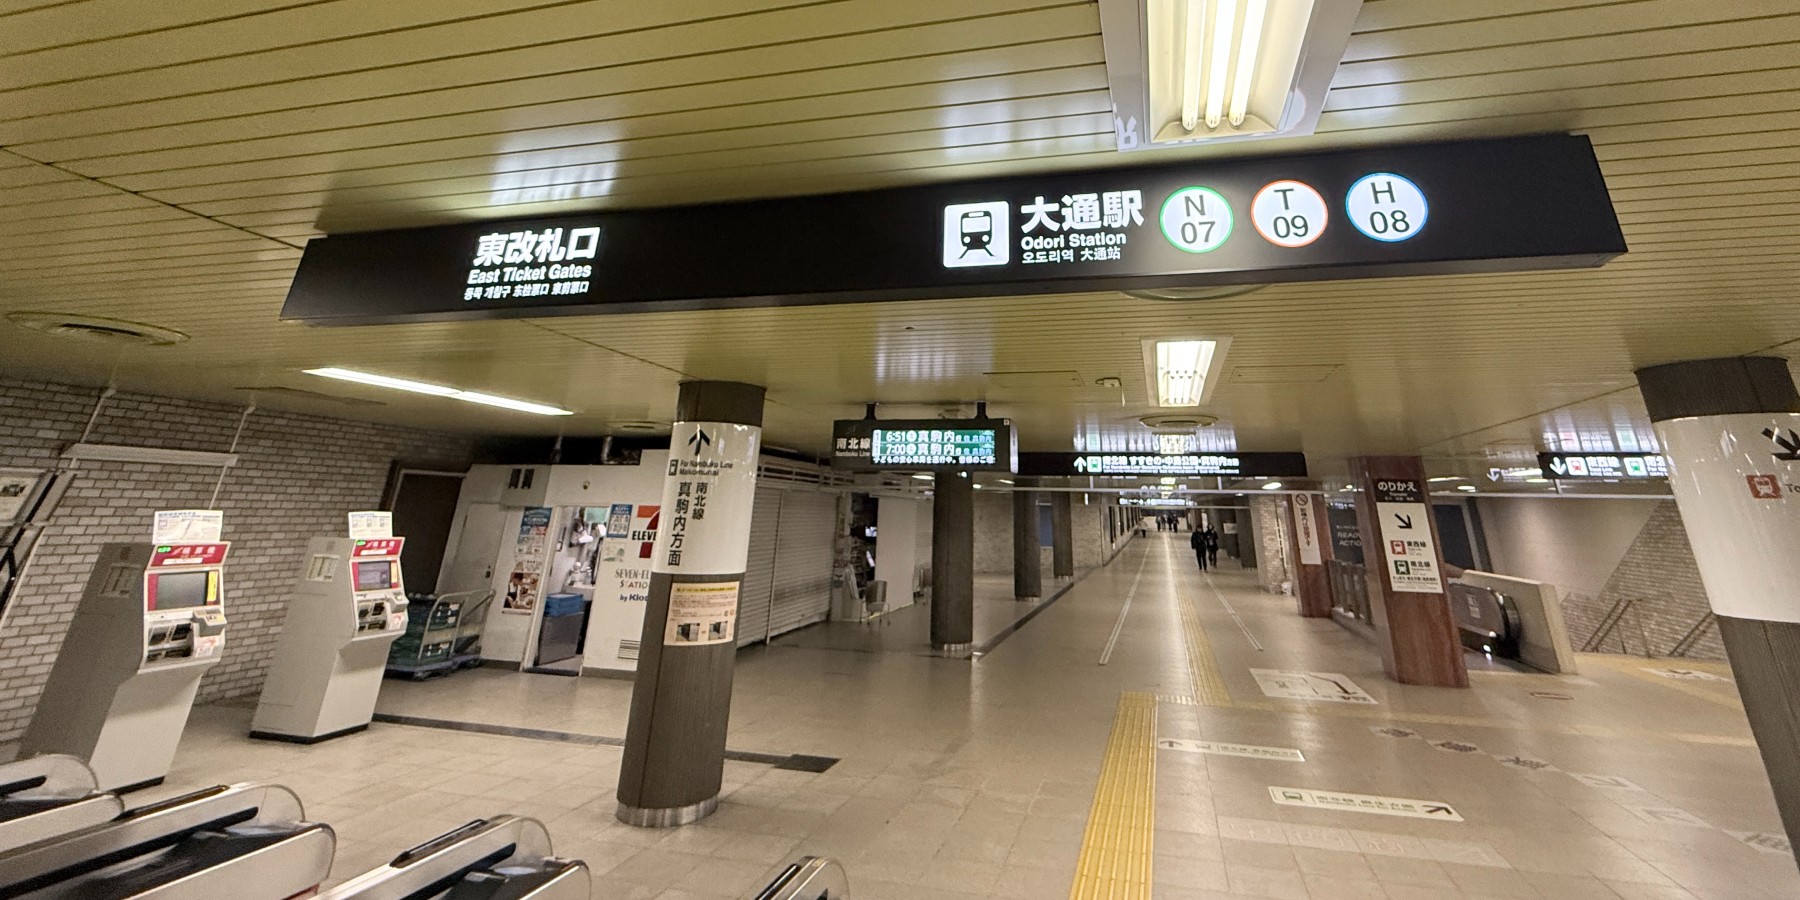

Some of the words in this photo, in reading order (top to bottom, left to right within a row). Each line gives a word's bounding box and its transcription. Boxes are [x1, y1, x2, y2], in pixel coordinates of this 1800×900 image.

[1273, 188, 1295, 209] T
[1371, 181, 1396, 204] H
[1020, 189, 1146, 234] 大通駅
[1184, 194, 1207, 217] N
[1180, 221, 1216, 245] 07
[1272, 215, 1309, 239] 09
[1369, 209, 1410, 234] 08
[473, 227, 601, 267] 東改札口
[1021, 234, 1064, 250] Odori
[1068, 232, 1127, 248] Station
[1022, 248, 1074, 264] 오도리역
[467, 268, 501, 285] East
[503, 265, 547, 283] Ticket
[548, 263, 592, 280] Gates
[836, 438, 871, 450] 南北線
[886, 431, 906, 442] 6:51
[917, 430, 955, 442] 真駒内
[886, 443, 906, 455] 7:00
[917, 443, 955, 455] 真駒内
[1377, 481, 1418, 492] のりかえ
[691, 482, 709, 520] 南北線
[668, 481, 692, 567] 真駒内方面
